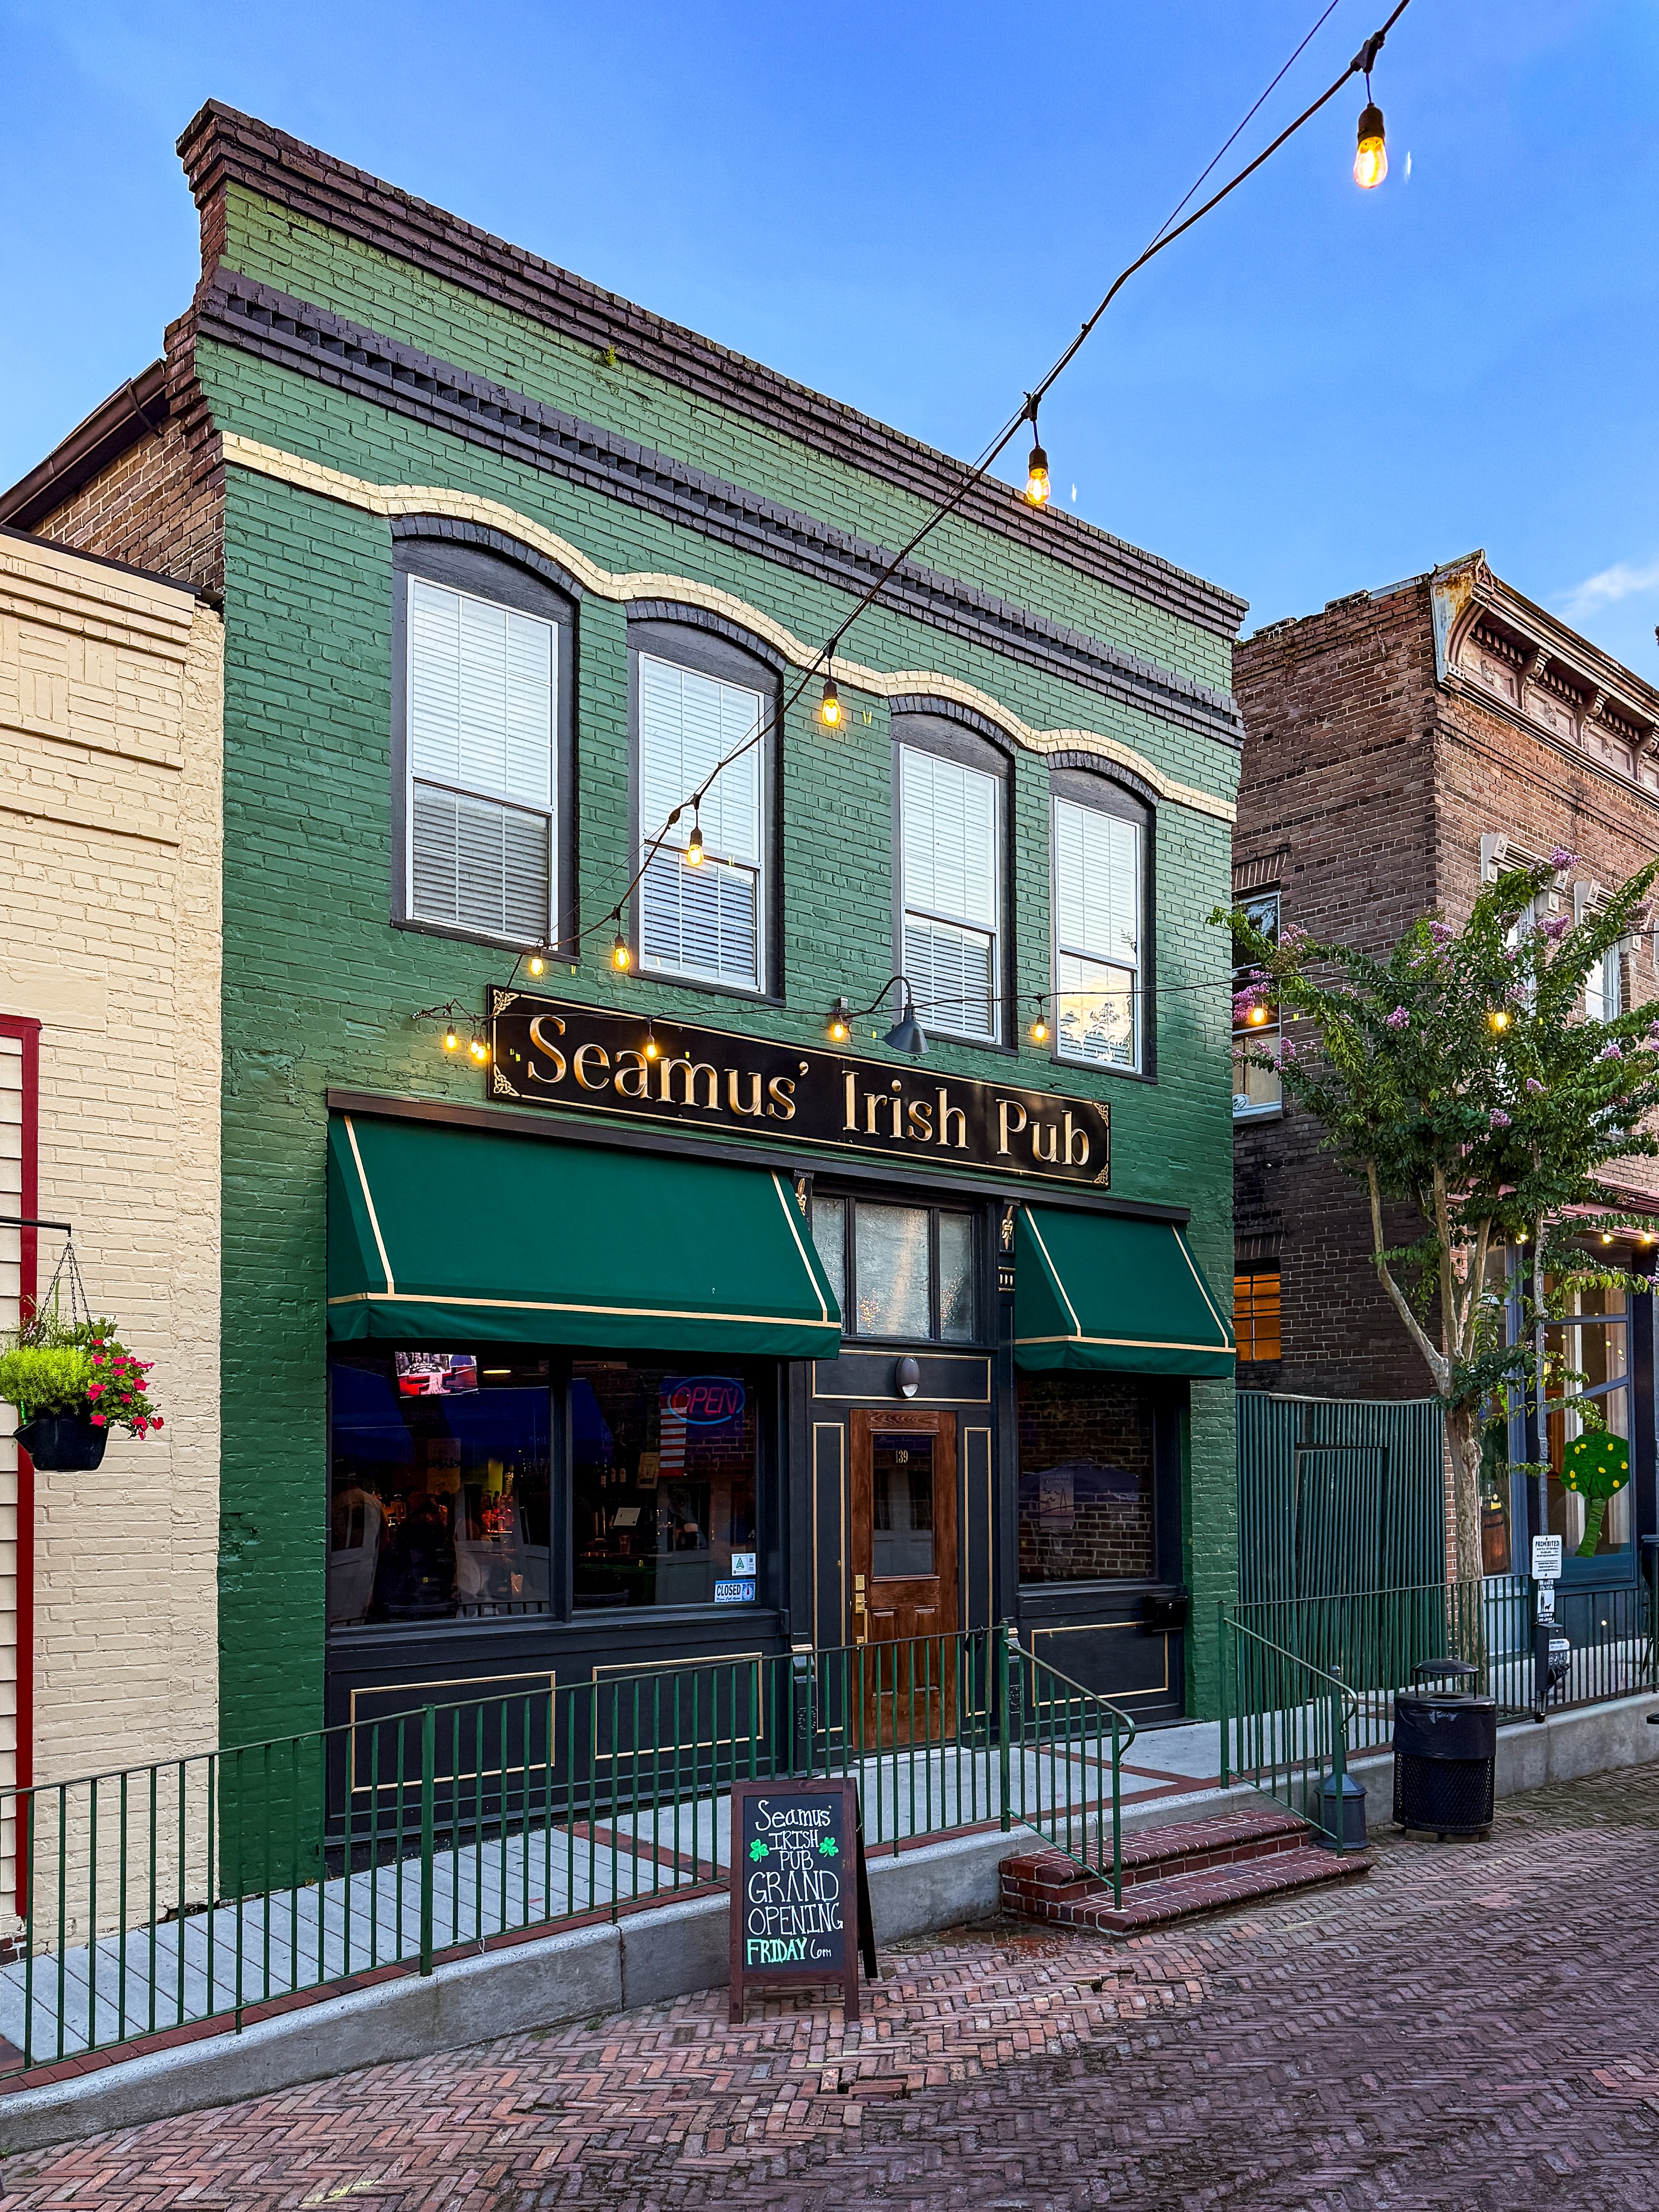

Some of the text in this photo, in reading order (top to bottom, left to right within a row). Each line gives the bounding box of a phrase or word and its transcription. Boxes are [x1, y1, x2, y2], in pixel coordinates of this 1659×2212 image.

[527, 1016, 1091, 1166] Seamus' Irish Pub
[673, 1386, 739, 1414] OPEN
[895, 1449, 908, 1463] 139
[736, 1557, 744, 1568] A
[717, 1584, 741, 1596] CLOSED
[755, 1799, 832, 1831] Seamus'
[768, 1829, 819, 1851] IRISH
[779, 1850, 814, 1871] PUB
[748, 1870, 839, 1904] GRAND
[748, 1901, 844, 1936] OPENING
[746, 1937, 807, 1965] FRIDAY
